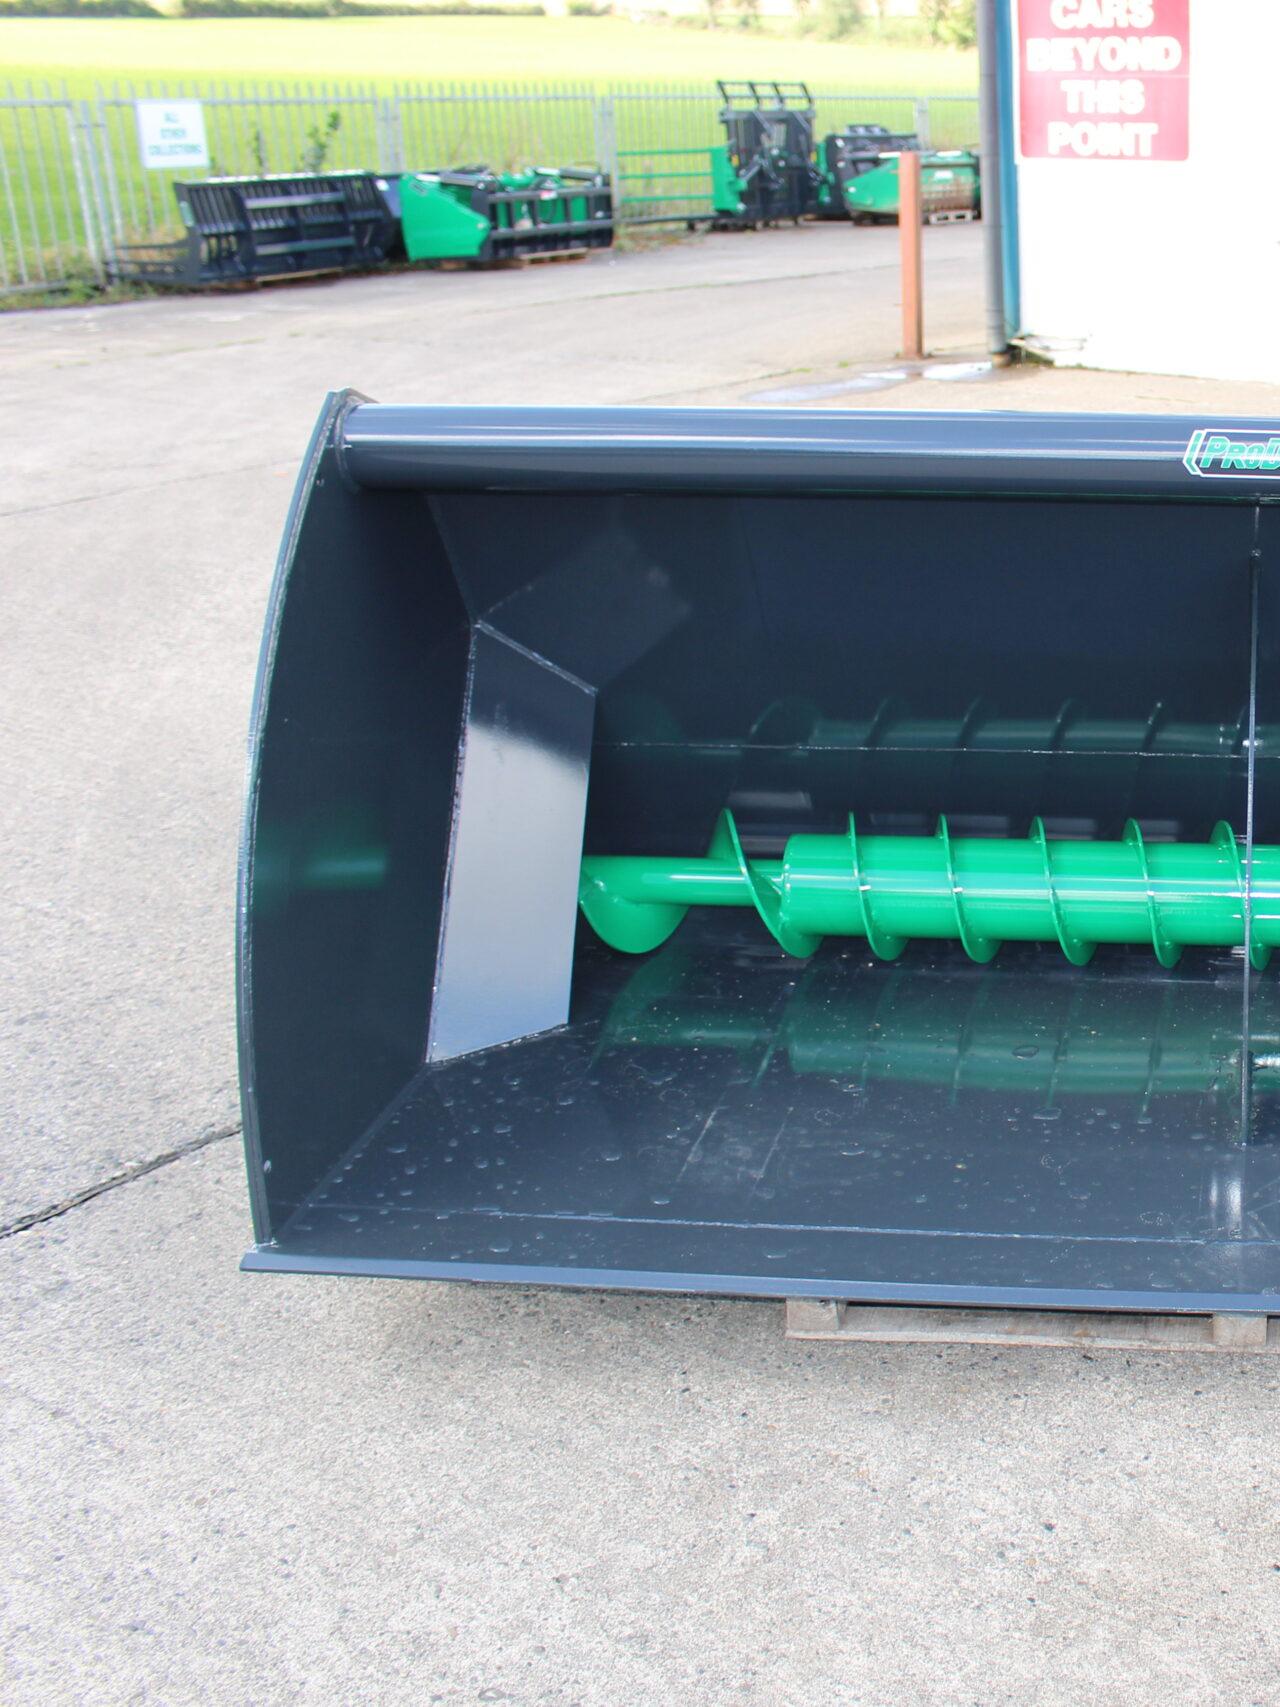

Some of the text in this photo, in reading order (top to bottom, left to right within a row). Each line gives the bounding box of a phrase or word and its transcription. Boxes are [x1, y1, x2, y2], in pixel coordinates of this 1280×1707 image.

[1050, 0, 1155, 29] CARS
[1026, 36, 1183, 72] BEYOND
[1060, 78, 1146, 115] THIS
[1047, 121, 1159, 157] POINT
